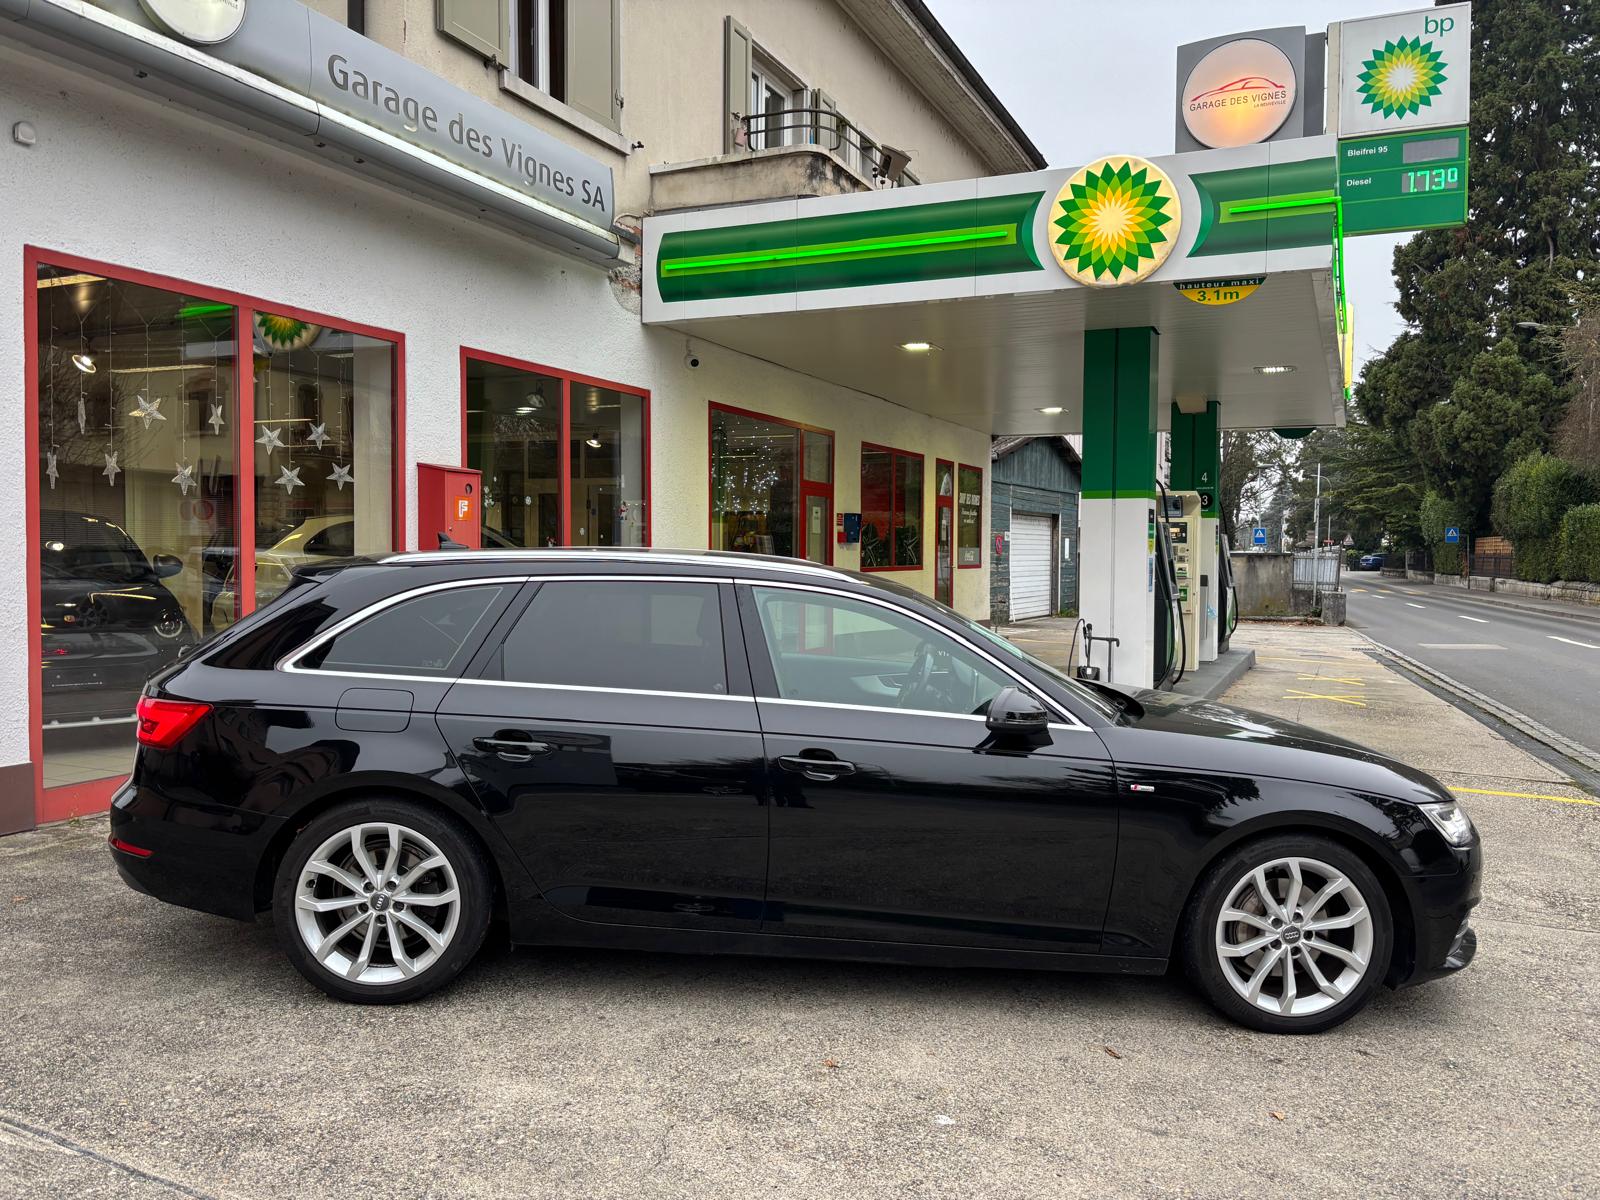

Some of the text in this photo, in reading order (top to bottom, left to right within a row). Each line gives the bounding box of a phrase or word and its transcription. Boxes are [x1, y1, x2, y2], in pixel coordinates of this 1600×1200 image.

[1425, 16, 1454, 37] bp
[1189, 90, 1287, 112] GARAGE DES VIGNES
[327, 54, 605, 212] Garage des Vignes SA
[1347, 145, 1388, 157] Bleifrei 95
[1346, 178, 1372, 187] Diesel
[1180, 277, 1259, 289] hauteur maxi
[1197, 289, 1240, 301] 3.1m
[1201, 472, 1208, 483] 4
[1202, 495, 1209, 506] 3
